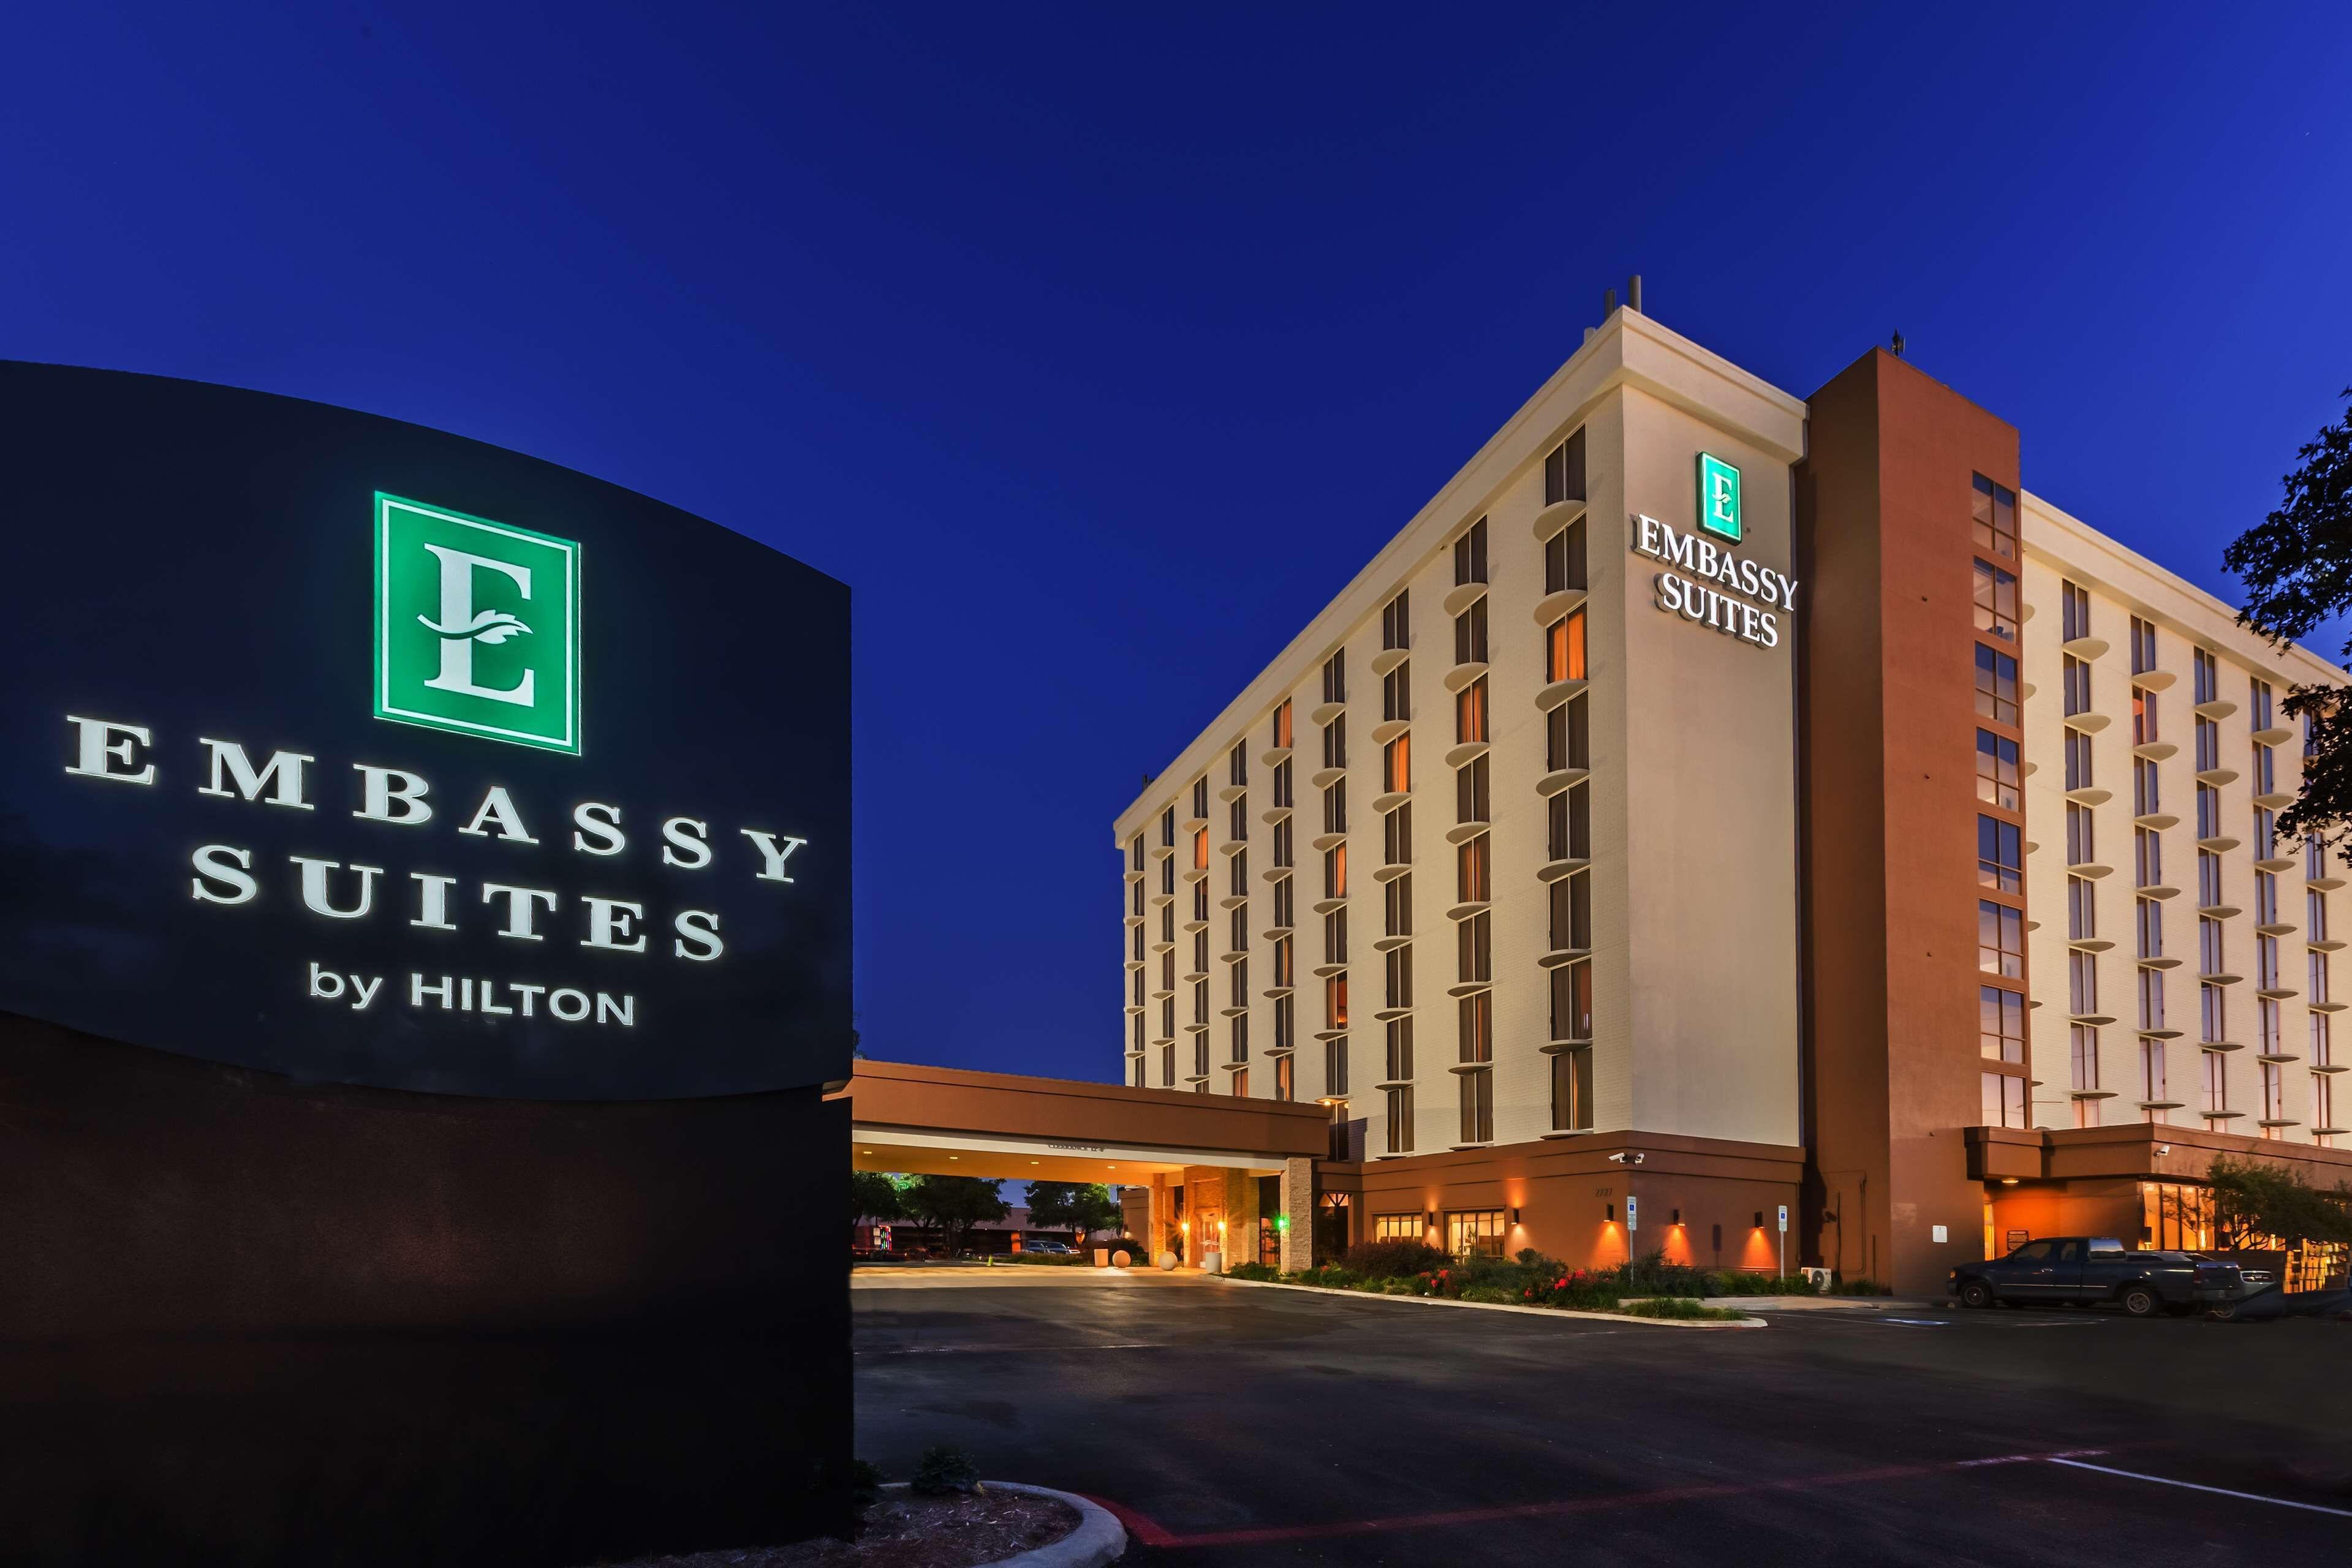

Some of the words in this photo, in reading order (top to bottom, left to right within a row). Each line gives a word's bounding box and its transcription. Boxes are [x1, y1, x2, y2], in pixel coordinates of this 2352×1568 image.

[1712, 472, 1734, 524] E
[1638, 513, 1798, 612] EMBASSY
[1662, 573, 1779, 648] SUITES
[417, 543, 535, 707] E
[65, 715, 807, 883] EMBASSY
[192, 845, 724, 961] SUITES
[309, 962, 383, 1009] by
[411, 973, 634, 1026] HILTON
